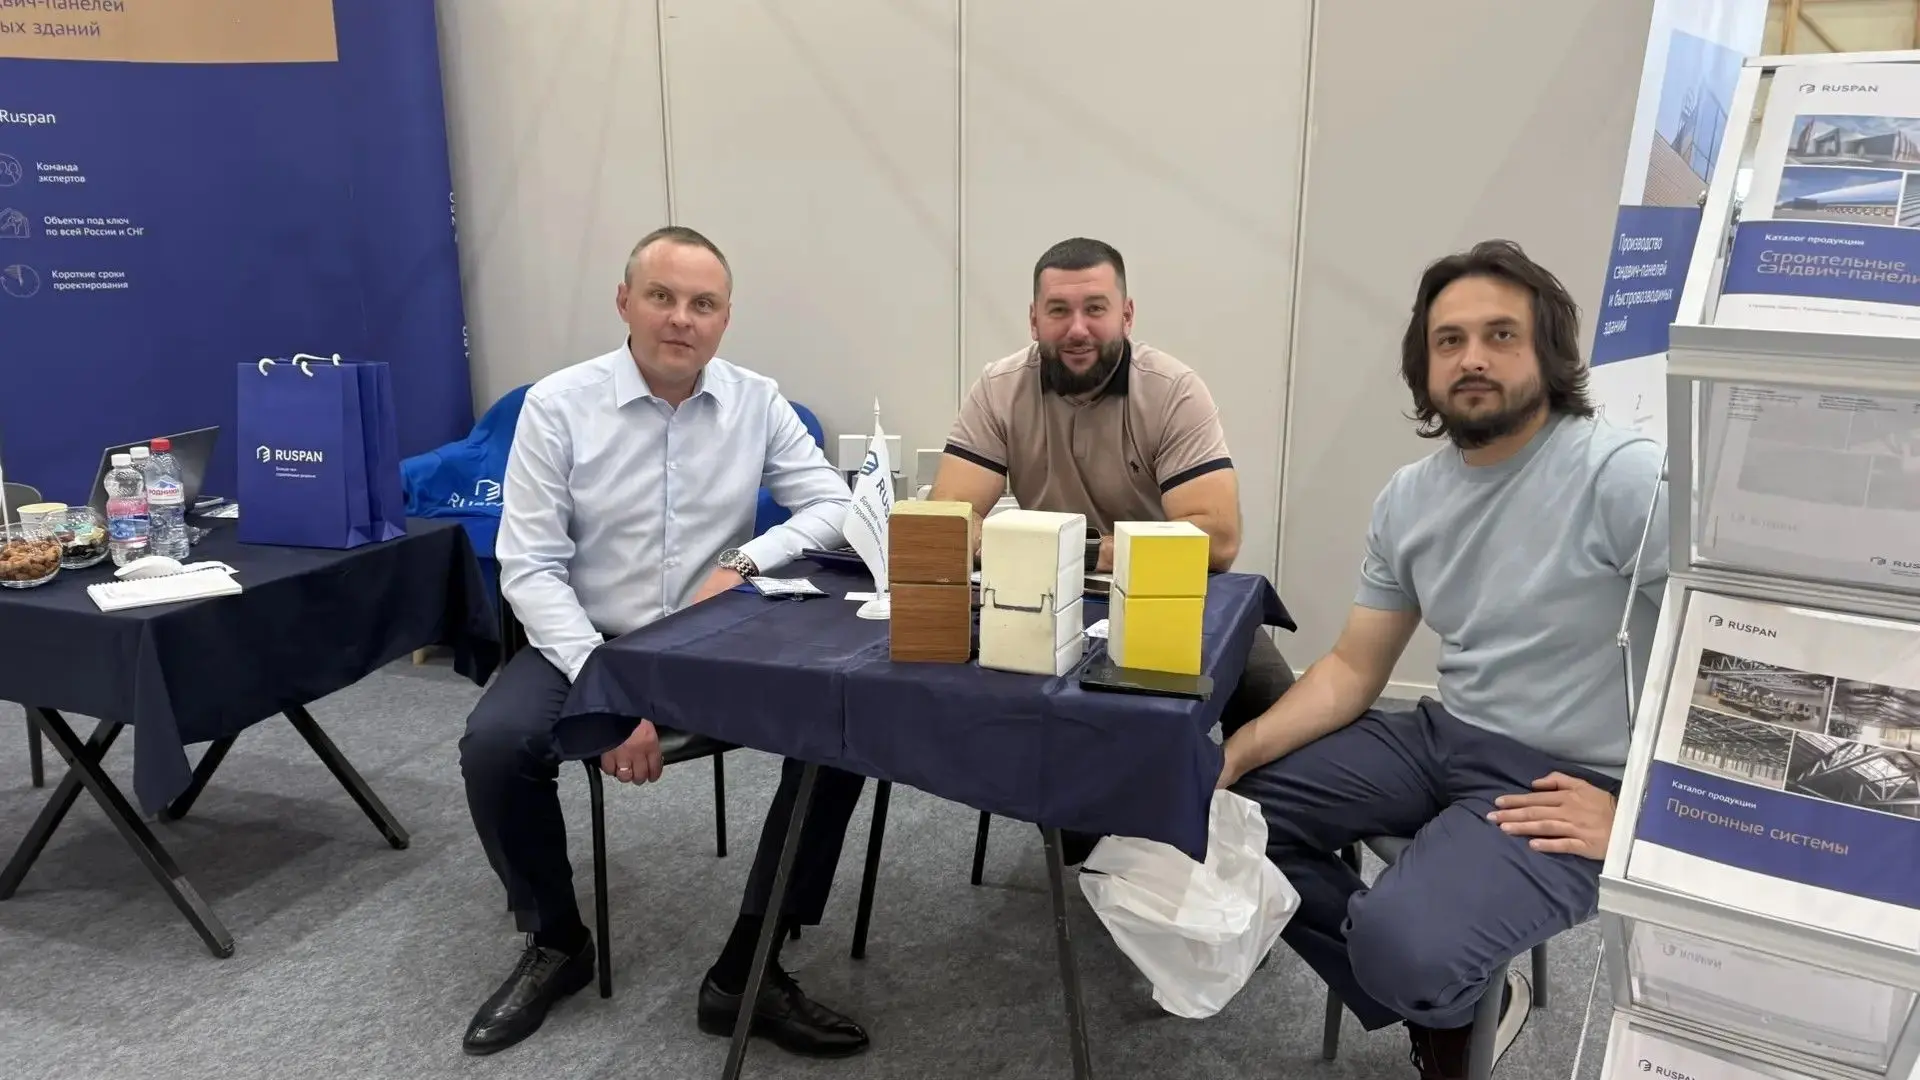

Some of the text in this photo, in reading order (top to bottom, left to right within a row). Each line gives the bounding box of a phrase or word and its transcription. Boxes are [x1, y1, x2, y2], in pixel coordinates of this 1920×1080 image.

[33, 21, 100, 38] зданий
[1822, 84, 1878, 92] RUSPAN
[0, 109, 56, 126] Ruspan
[36, 162, 78, 172] Команда
[39, 175, 86, 184] экспертов
[44, 216, 129, 226] Объекты под ключ
[46, 228, 58, 236] по
[60, 227, 81, 236] всей
[84, 228, 116, 236] России
[126, 227, 144, 236] СНГ
[1618, 233, 1663, 255] Производство
[1764, 233, 1865, 246] Каталог продукции
[1759, 249, 1906, 272] Строительные
[52, 270, 125, 280] Короткие сроки
[53, 282, 129, 291] проектирования
[275, 449, 323, 462] RUSPAN
[1728, 620, 1777, 638] RUSPAN
[1671, 780, 1757, 809] Каталог продукции
[1666, 797, 1849, 856] Прогонные системы
